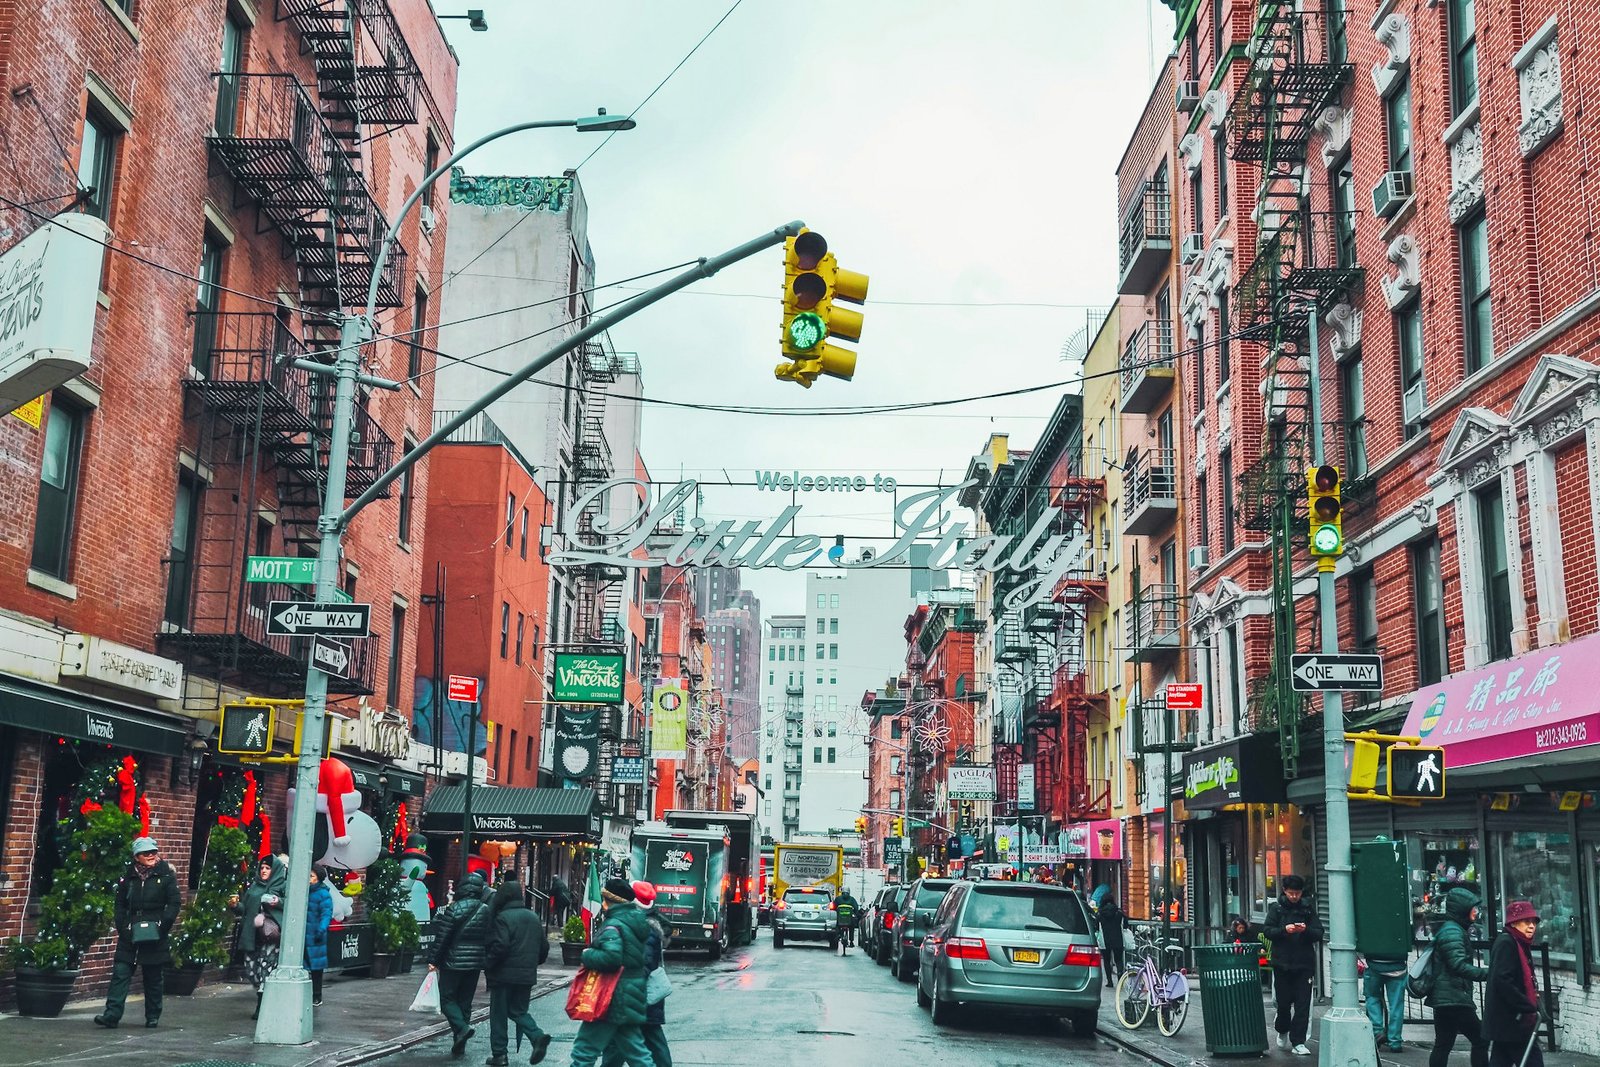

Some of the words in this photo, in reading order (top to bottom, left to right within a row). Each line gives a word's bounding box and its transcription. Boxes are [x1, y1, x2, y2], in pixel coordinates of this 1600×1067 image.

[755, 470, 866, 492] Welcome
[873, 473, 898, 493] to
[546, 478, 824, 571] Little
[827, 478, 1100, 611] Italy
[251, 560, 293, 579] MOTT
[302, 561, 314, 572] ST
[284, 612, 312, 625] ONE
[326, 613, 356, 626] WAY
[317, 646, 329, 662] ONE
[332, 651, 345, 668] WAY
[571, 660, 588, 670] The
[1305, 666, 1334, 679] ONE
[1347, 666, 1374, 679] WAY
[1465, 655, 1562, 712] 精品廊
[952, 769, 993, 780] PUGLIA
